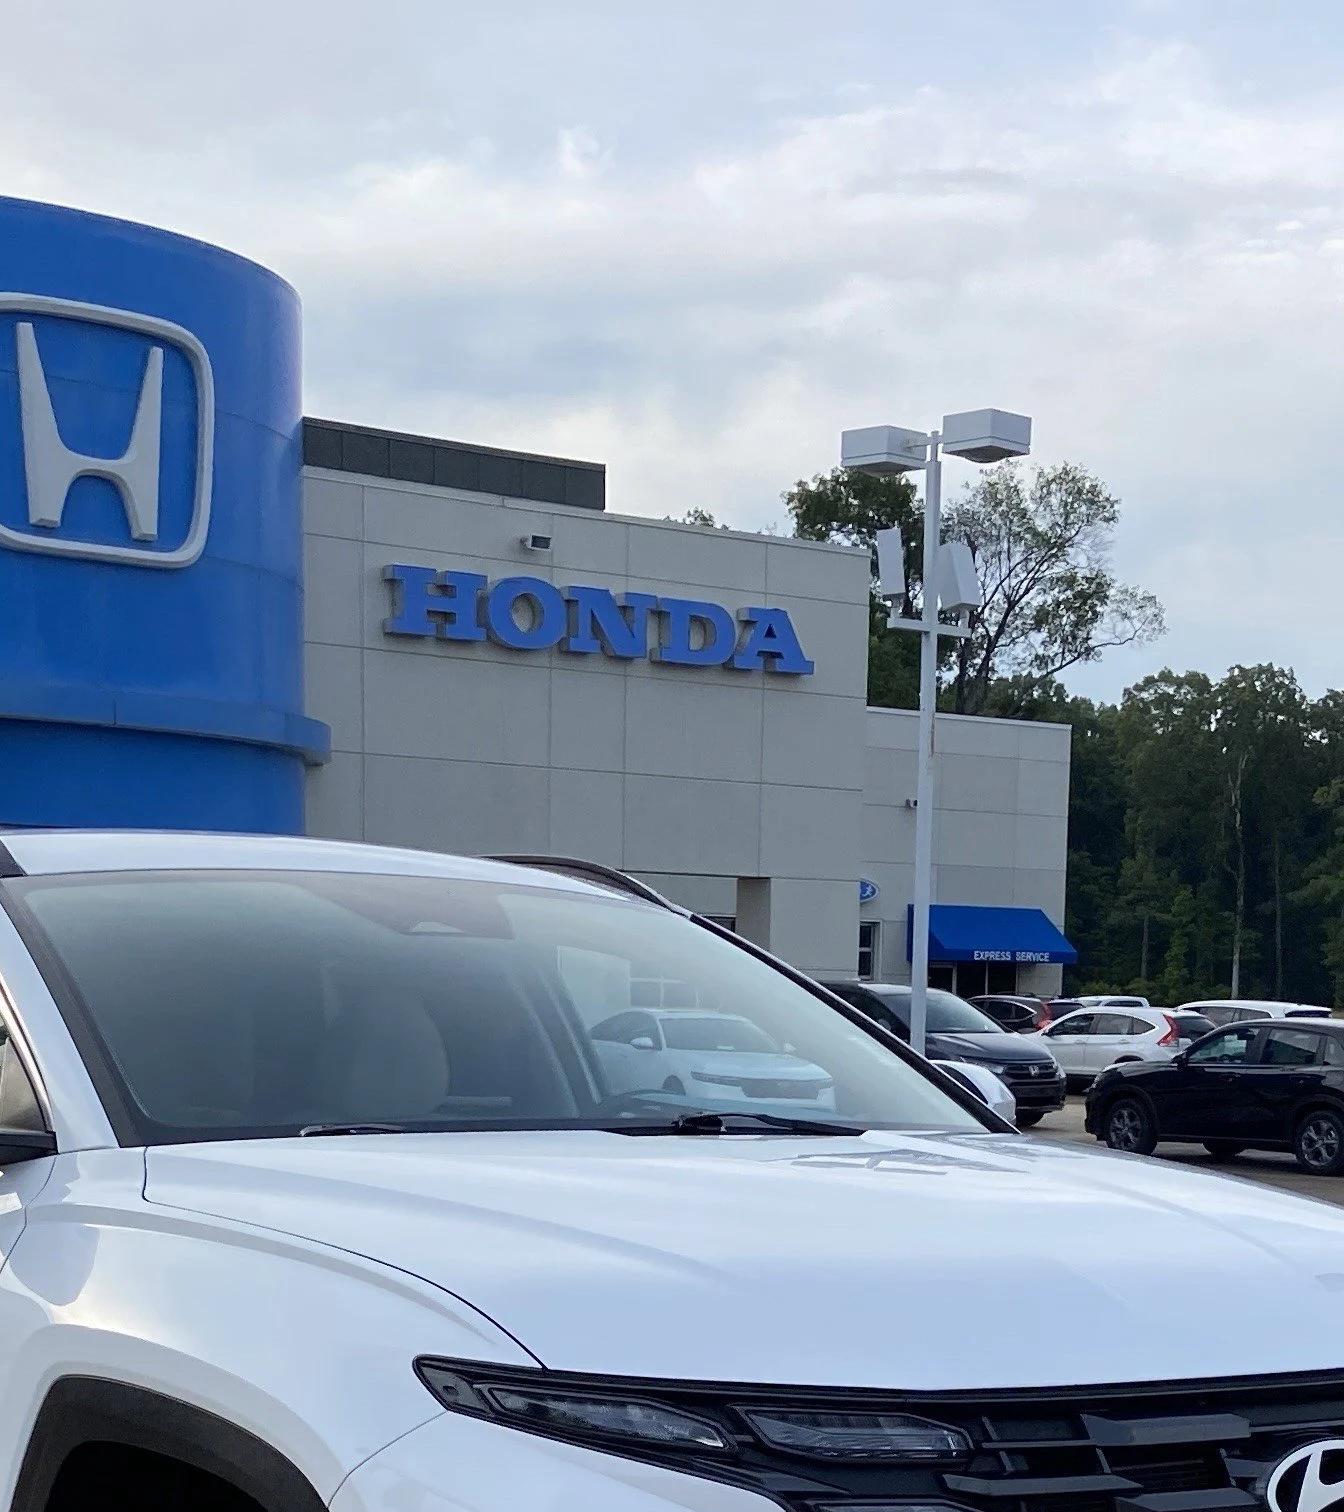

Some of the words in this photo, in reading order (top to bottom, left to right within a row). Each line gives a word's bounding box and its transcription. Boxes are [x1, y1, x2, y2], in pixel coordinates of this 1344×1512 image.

[383, 564, 815, 675] HONDA
[973, 950, 1011, 961] EXPRESS
[1015, 951, 1050, 962] SERVICE
